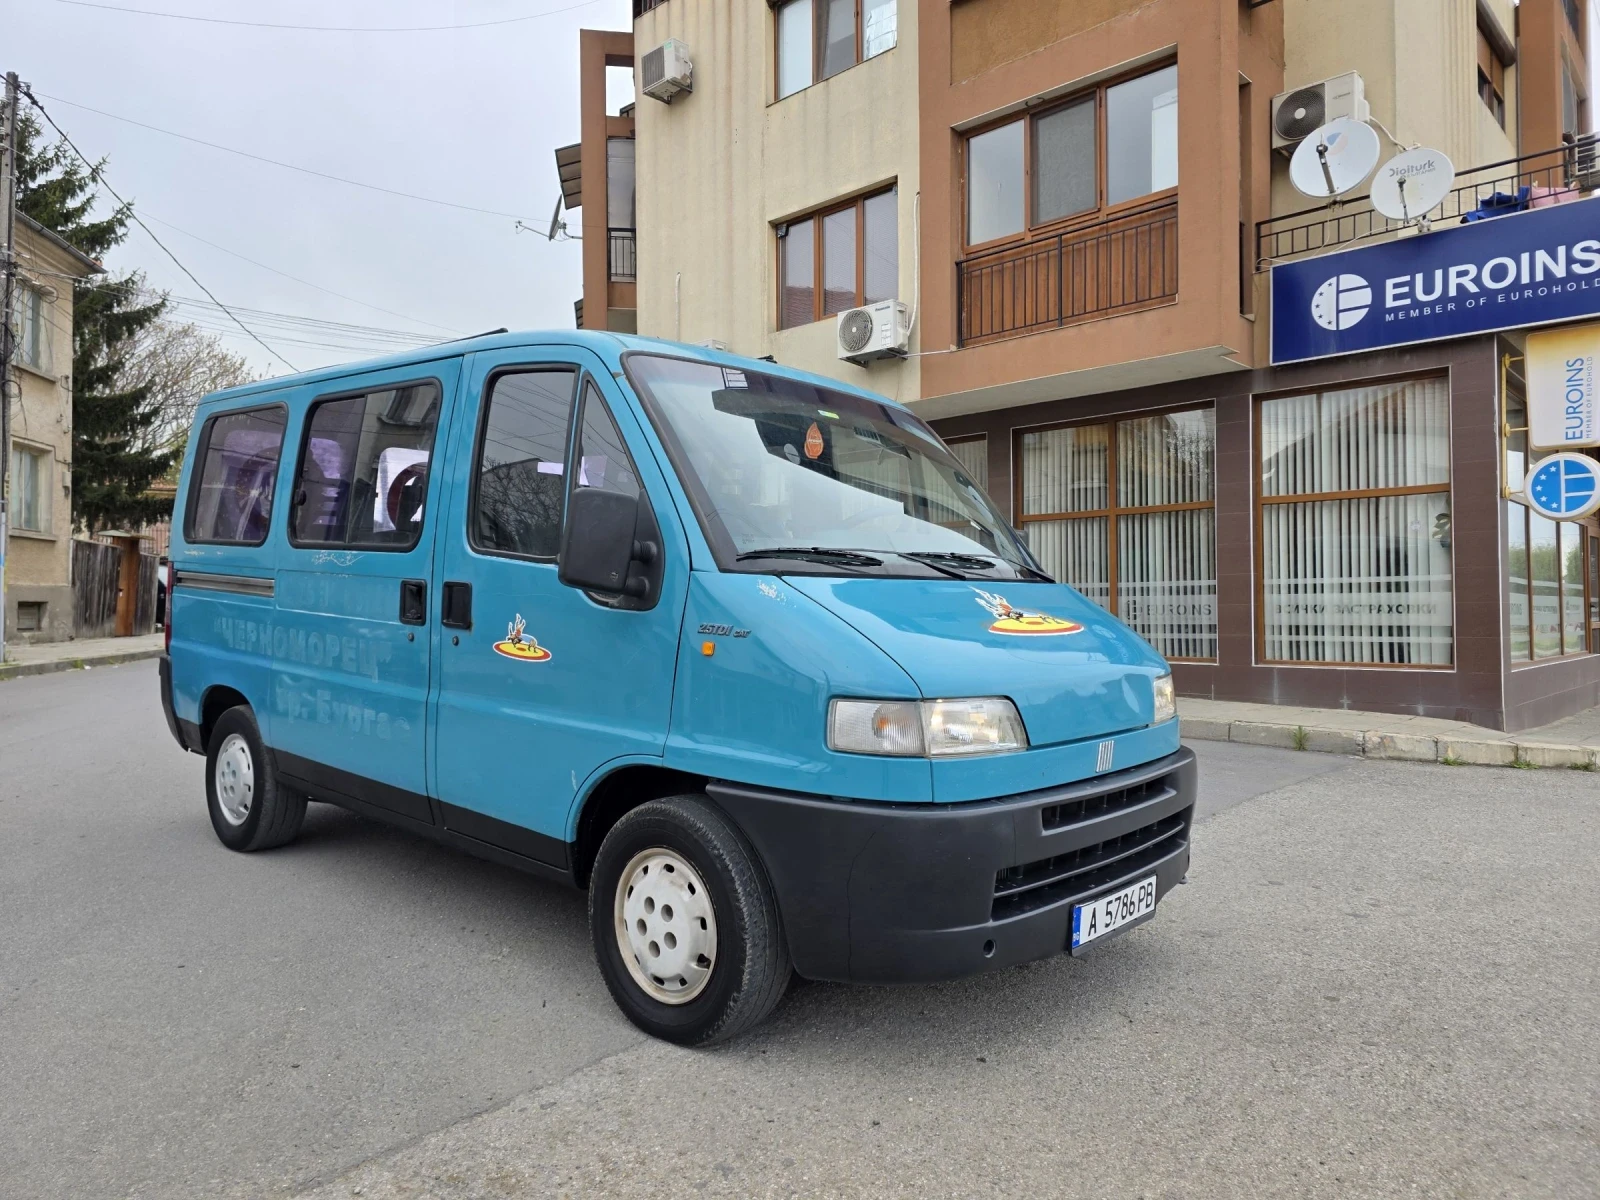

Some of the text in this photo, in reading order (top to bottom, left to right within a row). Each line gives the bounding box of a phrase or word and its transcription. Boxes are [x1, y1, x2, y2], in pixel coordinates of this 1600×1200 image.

[1385, 239, 1600, 309] EUROINS
[1385, 302, 1456, 322] MEMBER
[1466, 296, 1487, 308] OF
[1565, 357, 1585, 441] EUROINS
[1586, 399, 1593, 408] OF
[1146, 603, 1212, 616] EURONS
